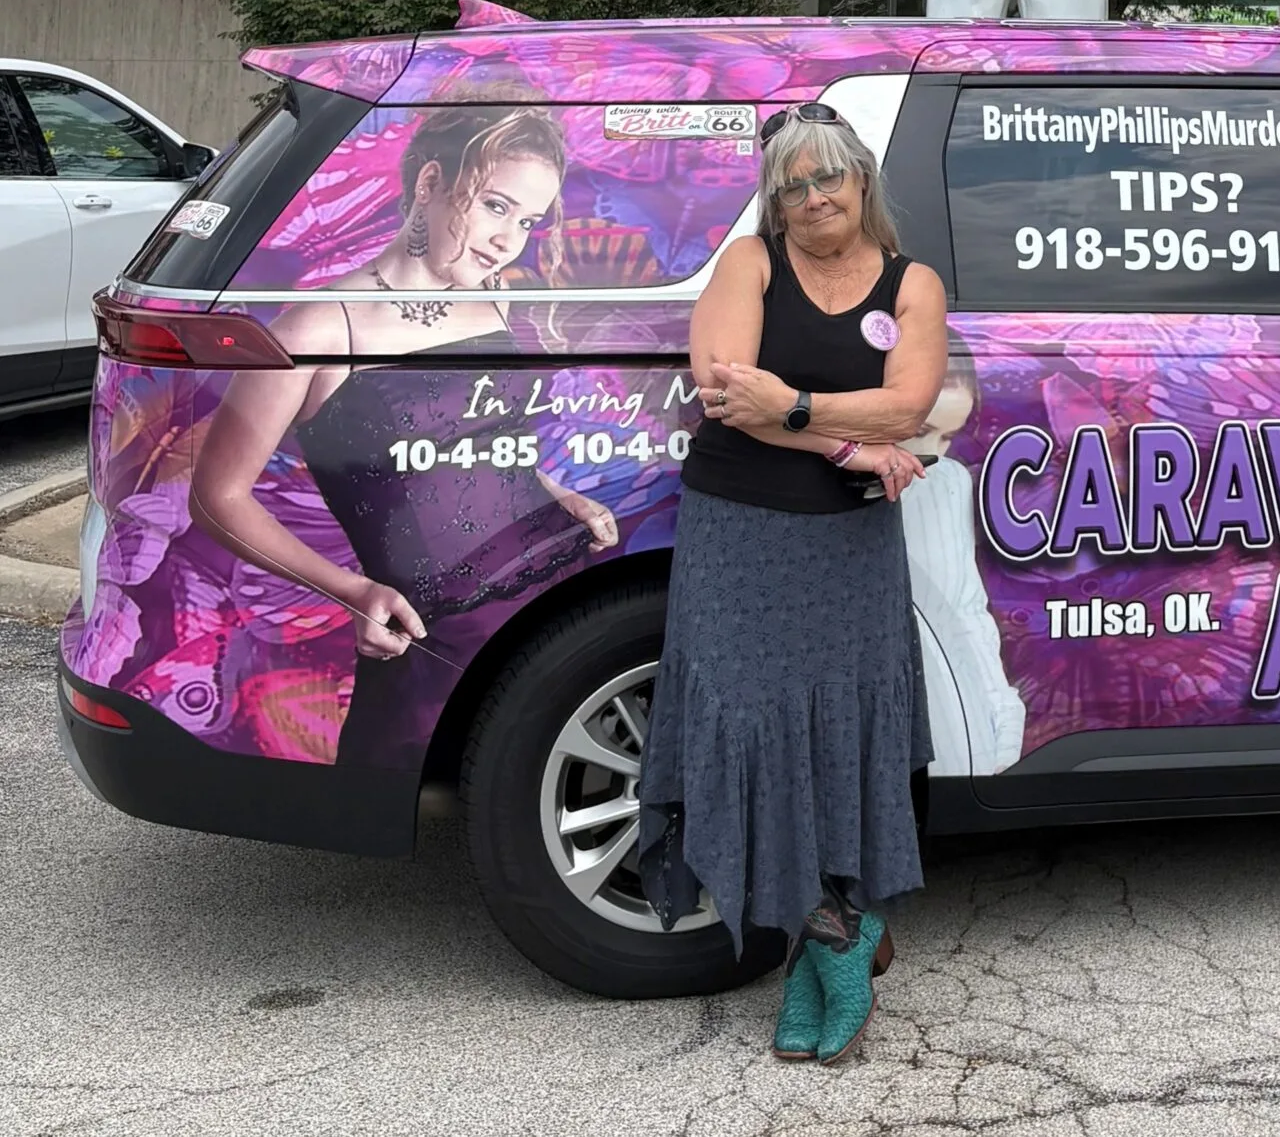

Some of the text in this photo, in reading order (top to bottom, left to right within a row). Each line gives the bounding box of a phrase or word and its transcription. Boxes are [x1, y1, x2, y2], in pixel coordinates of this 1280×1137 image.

[610, 107, 651, 115] driving
[620, 111, 692, 132] Britt
[712, 118, 745, 131] 66
[1110, 170, 1244, 213] TIPS?
[196, 216, 214, 230] 66
[462, 374, 513, 419] In
[524, 378, 644, 428] Loving
[389, 435, 538, 472] 10-4-85
[1045, 592, 1222, 640] Tulsa, OK.
